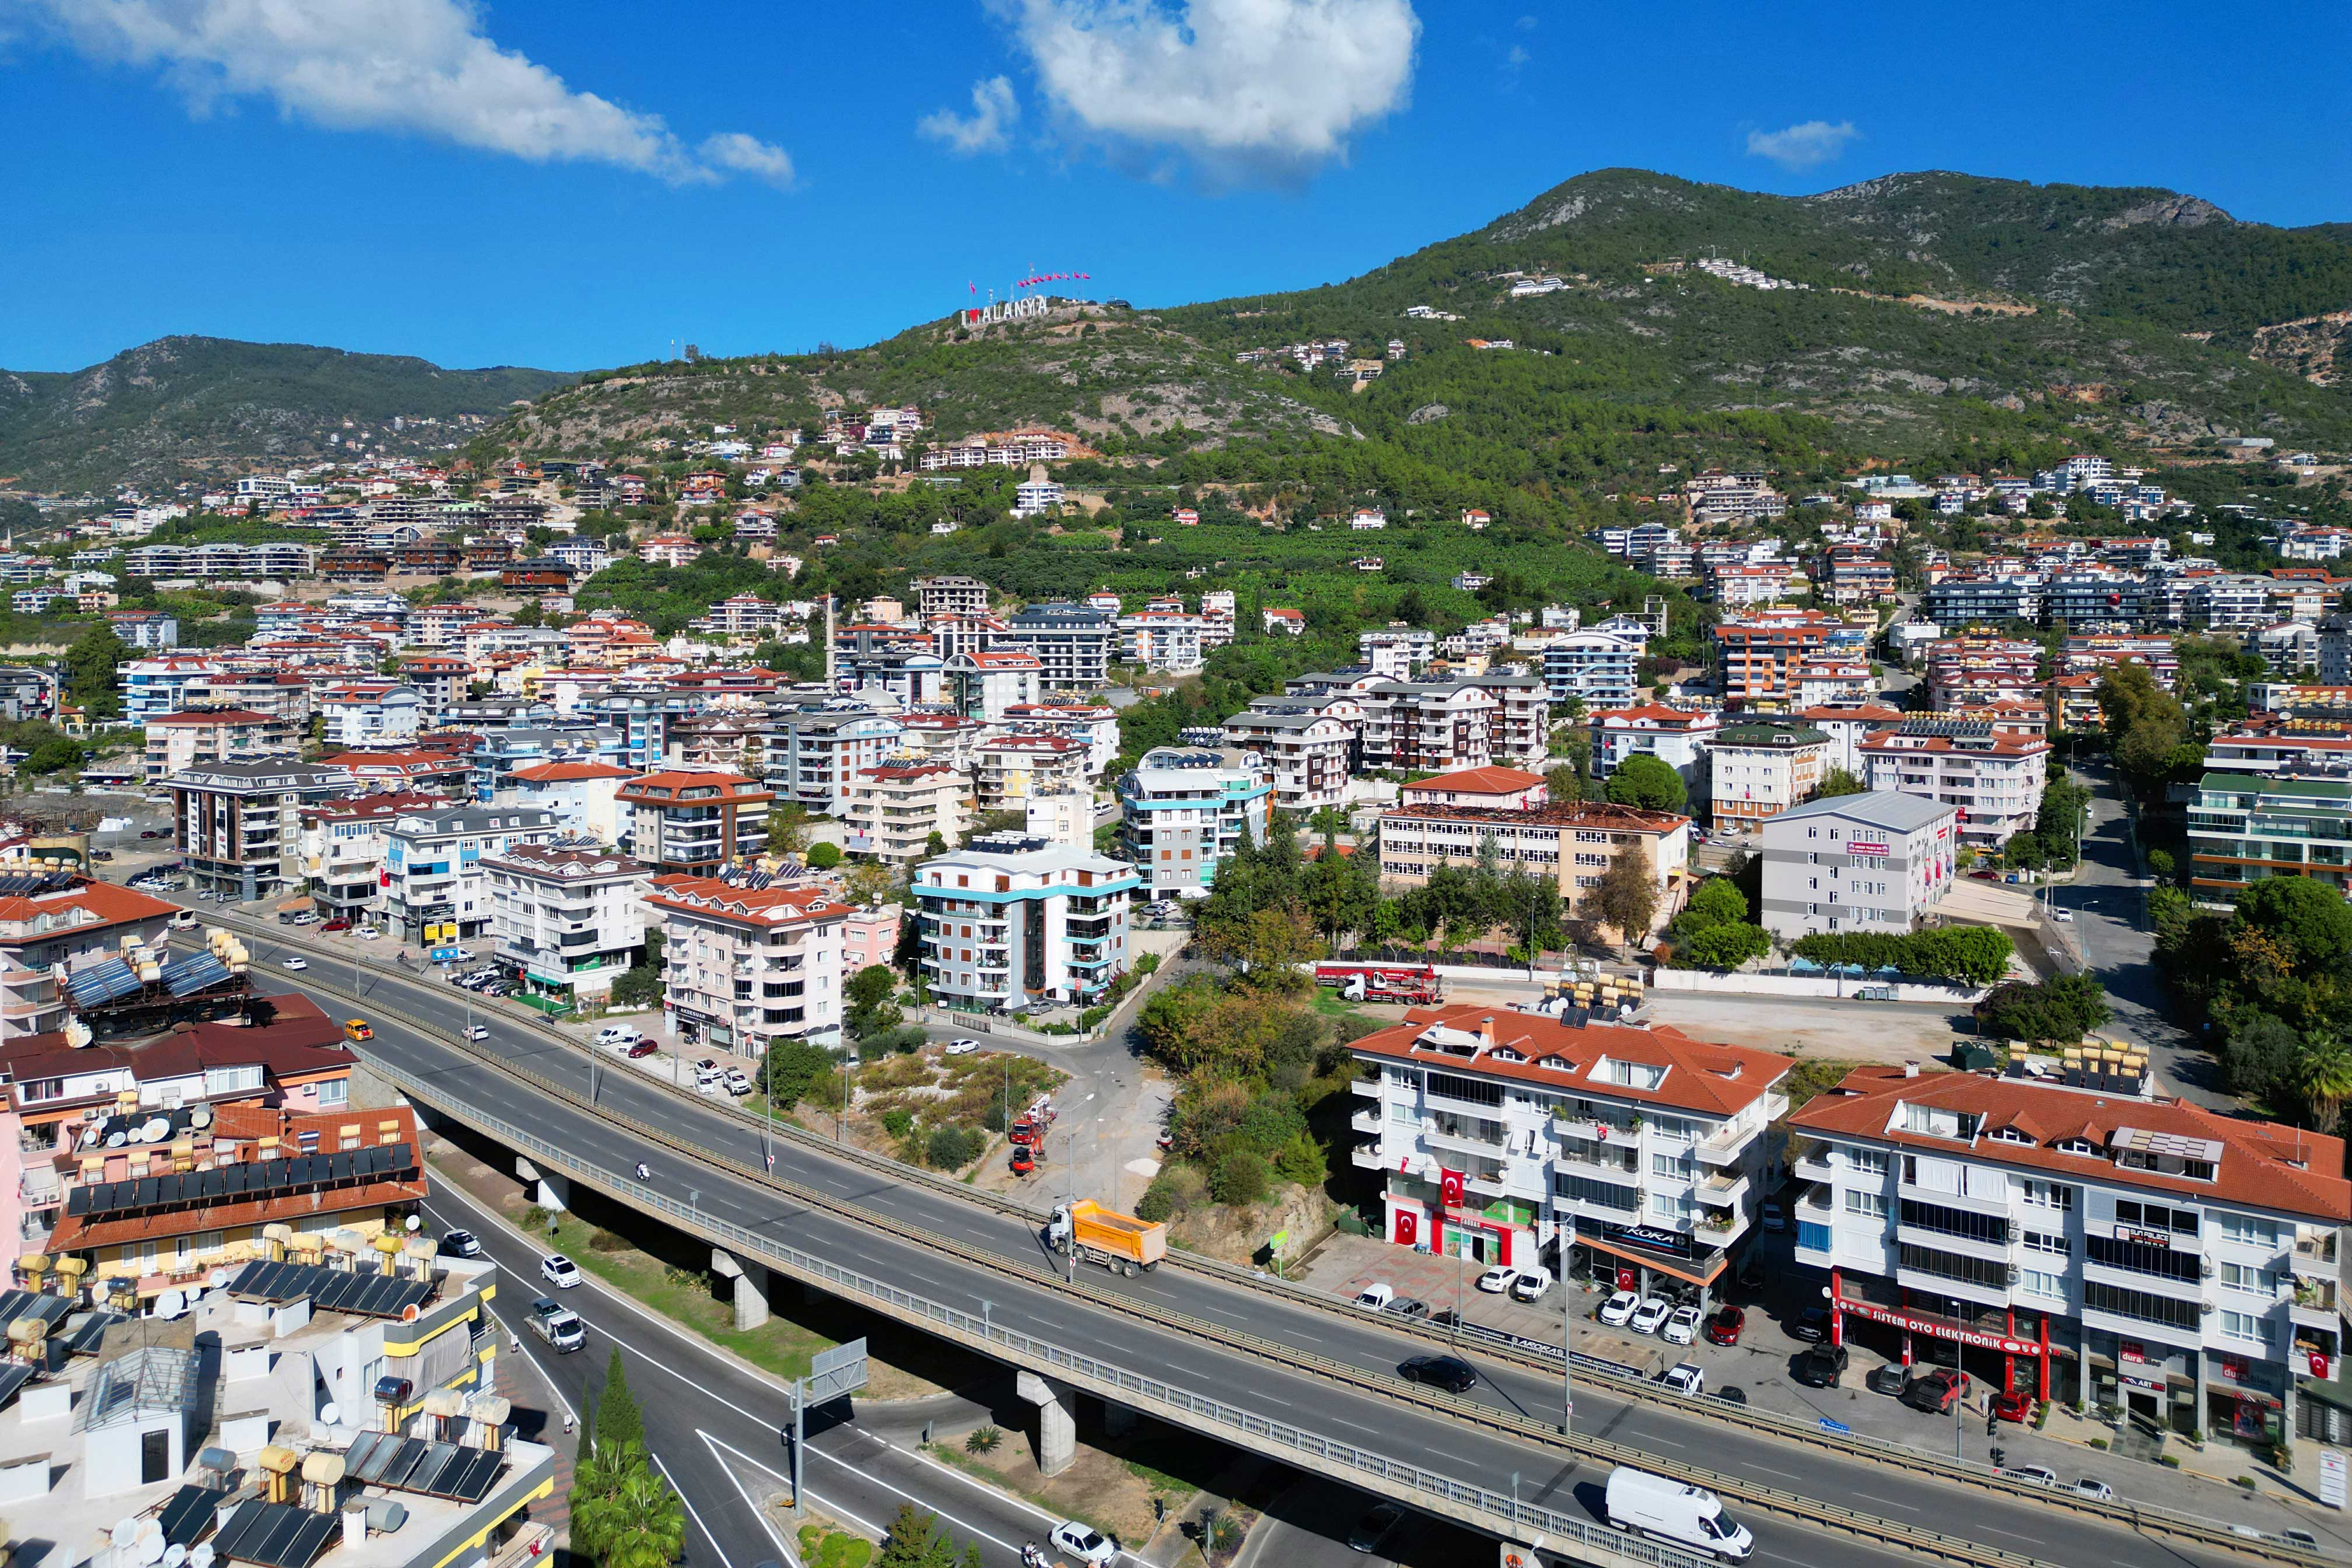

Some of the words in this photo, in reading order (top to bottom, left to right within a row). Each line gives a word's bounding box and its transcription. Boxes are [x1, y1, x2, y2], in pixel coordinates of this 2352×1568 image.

[982, 295, 1046, 323] ALANYA
[1615, 1226, 1674, 1243] ARORA
[1909, 1321, 1933, 1334] OTO
[1518, 1340, 1558, 1353] ARORA
